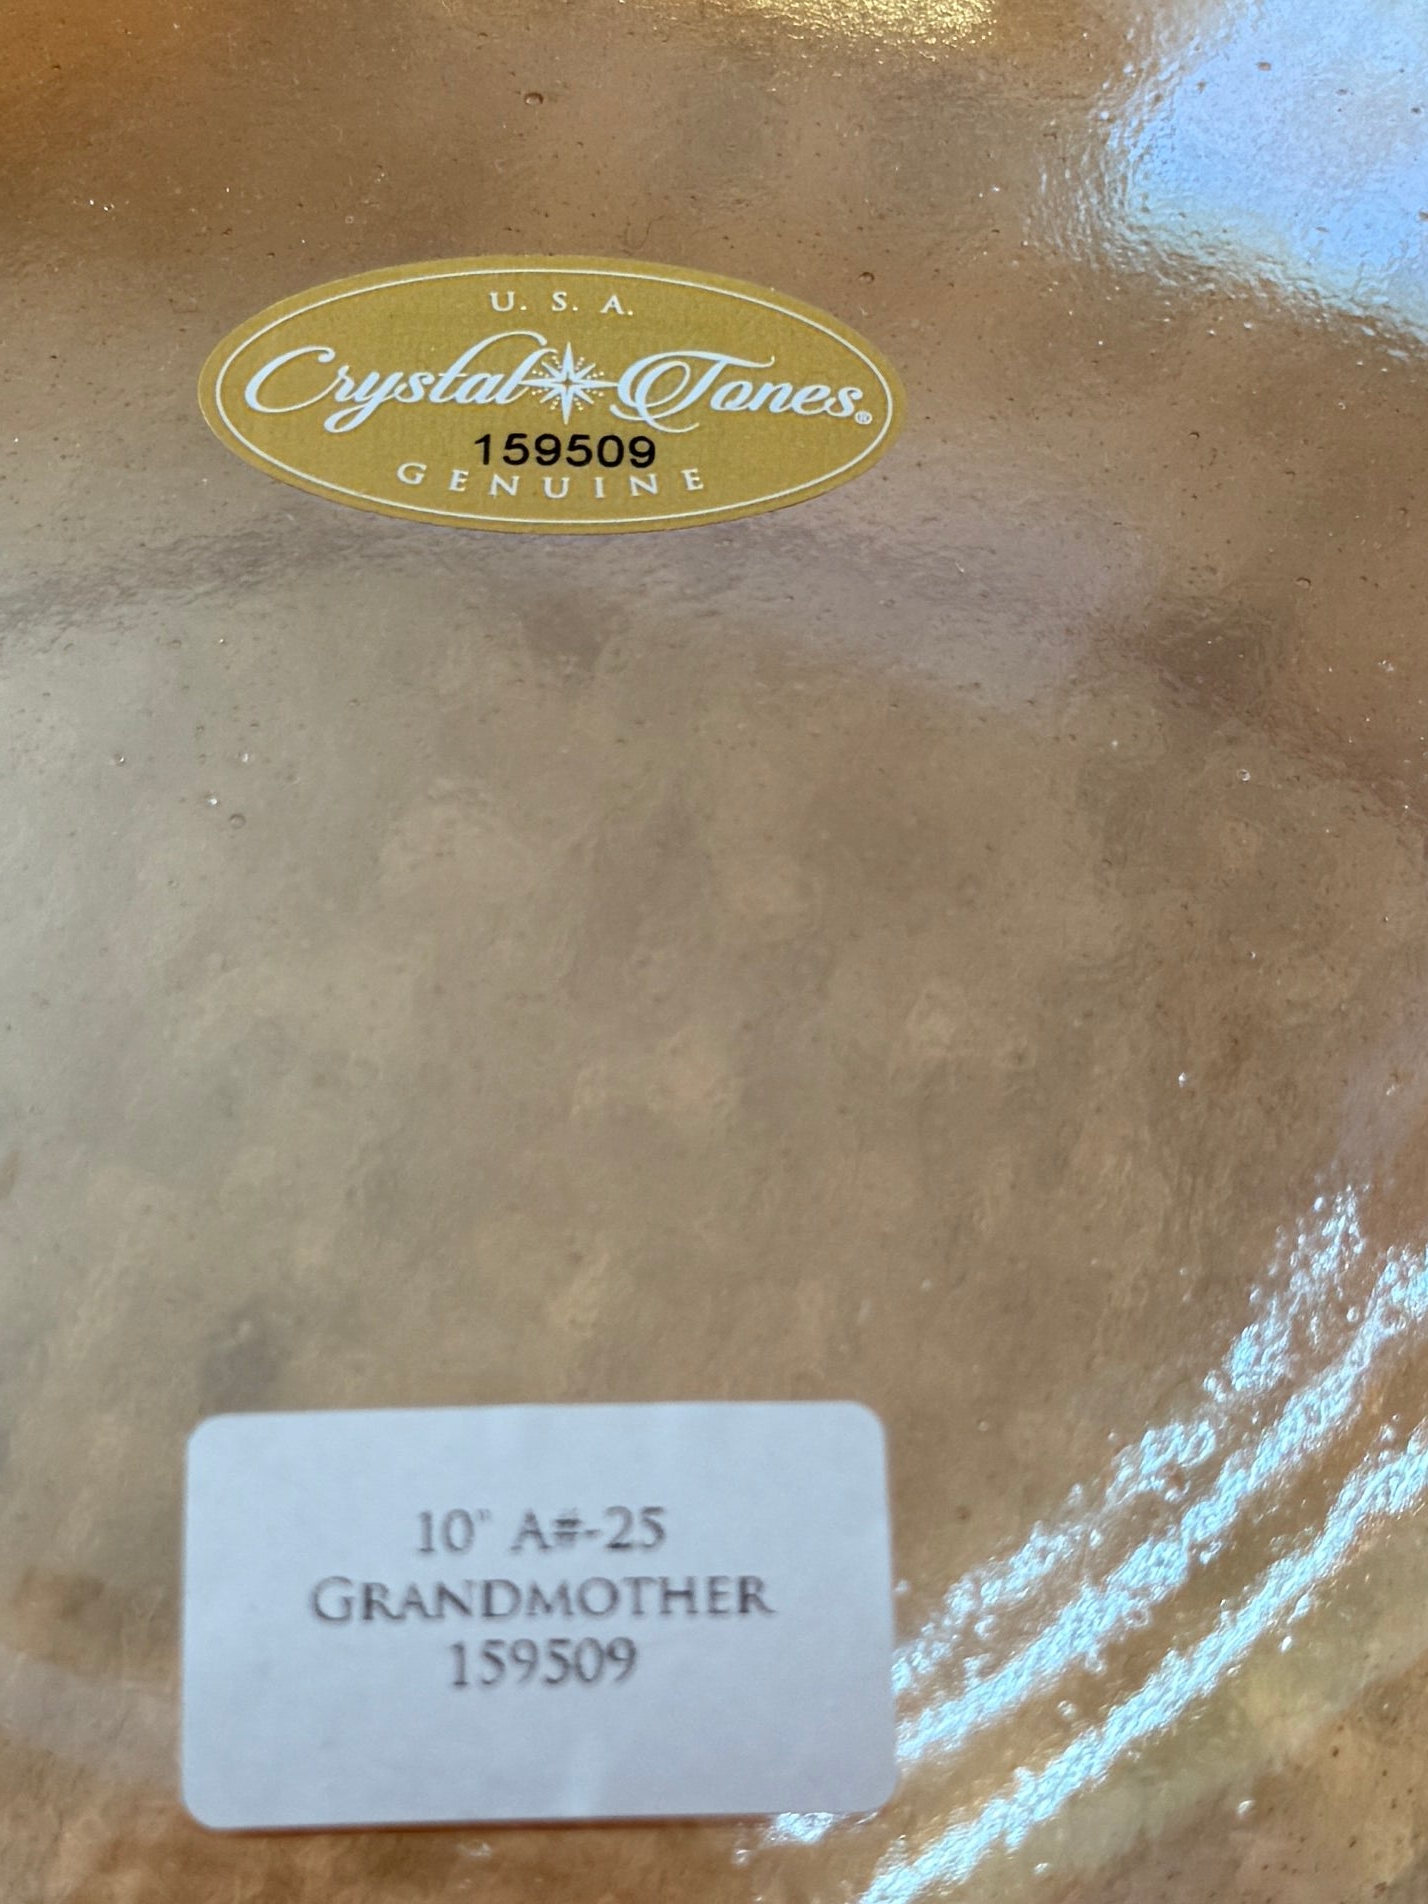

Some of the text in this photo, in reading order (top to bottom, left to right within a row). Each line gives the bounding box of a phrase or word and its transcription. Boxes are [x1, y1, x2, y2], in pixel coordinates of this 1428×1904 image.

[244, 330, 558, 434] Crystal
[472, 432, 657, 469] 159509
[397, 461, 704, 498] GENUINE
[416, 1505, 668, 1555] 10" A#-25
[308, 1574, 776, 1623] GRANDMOTHER
[450, 1636, 638, 1688] 159509
